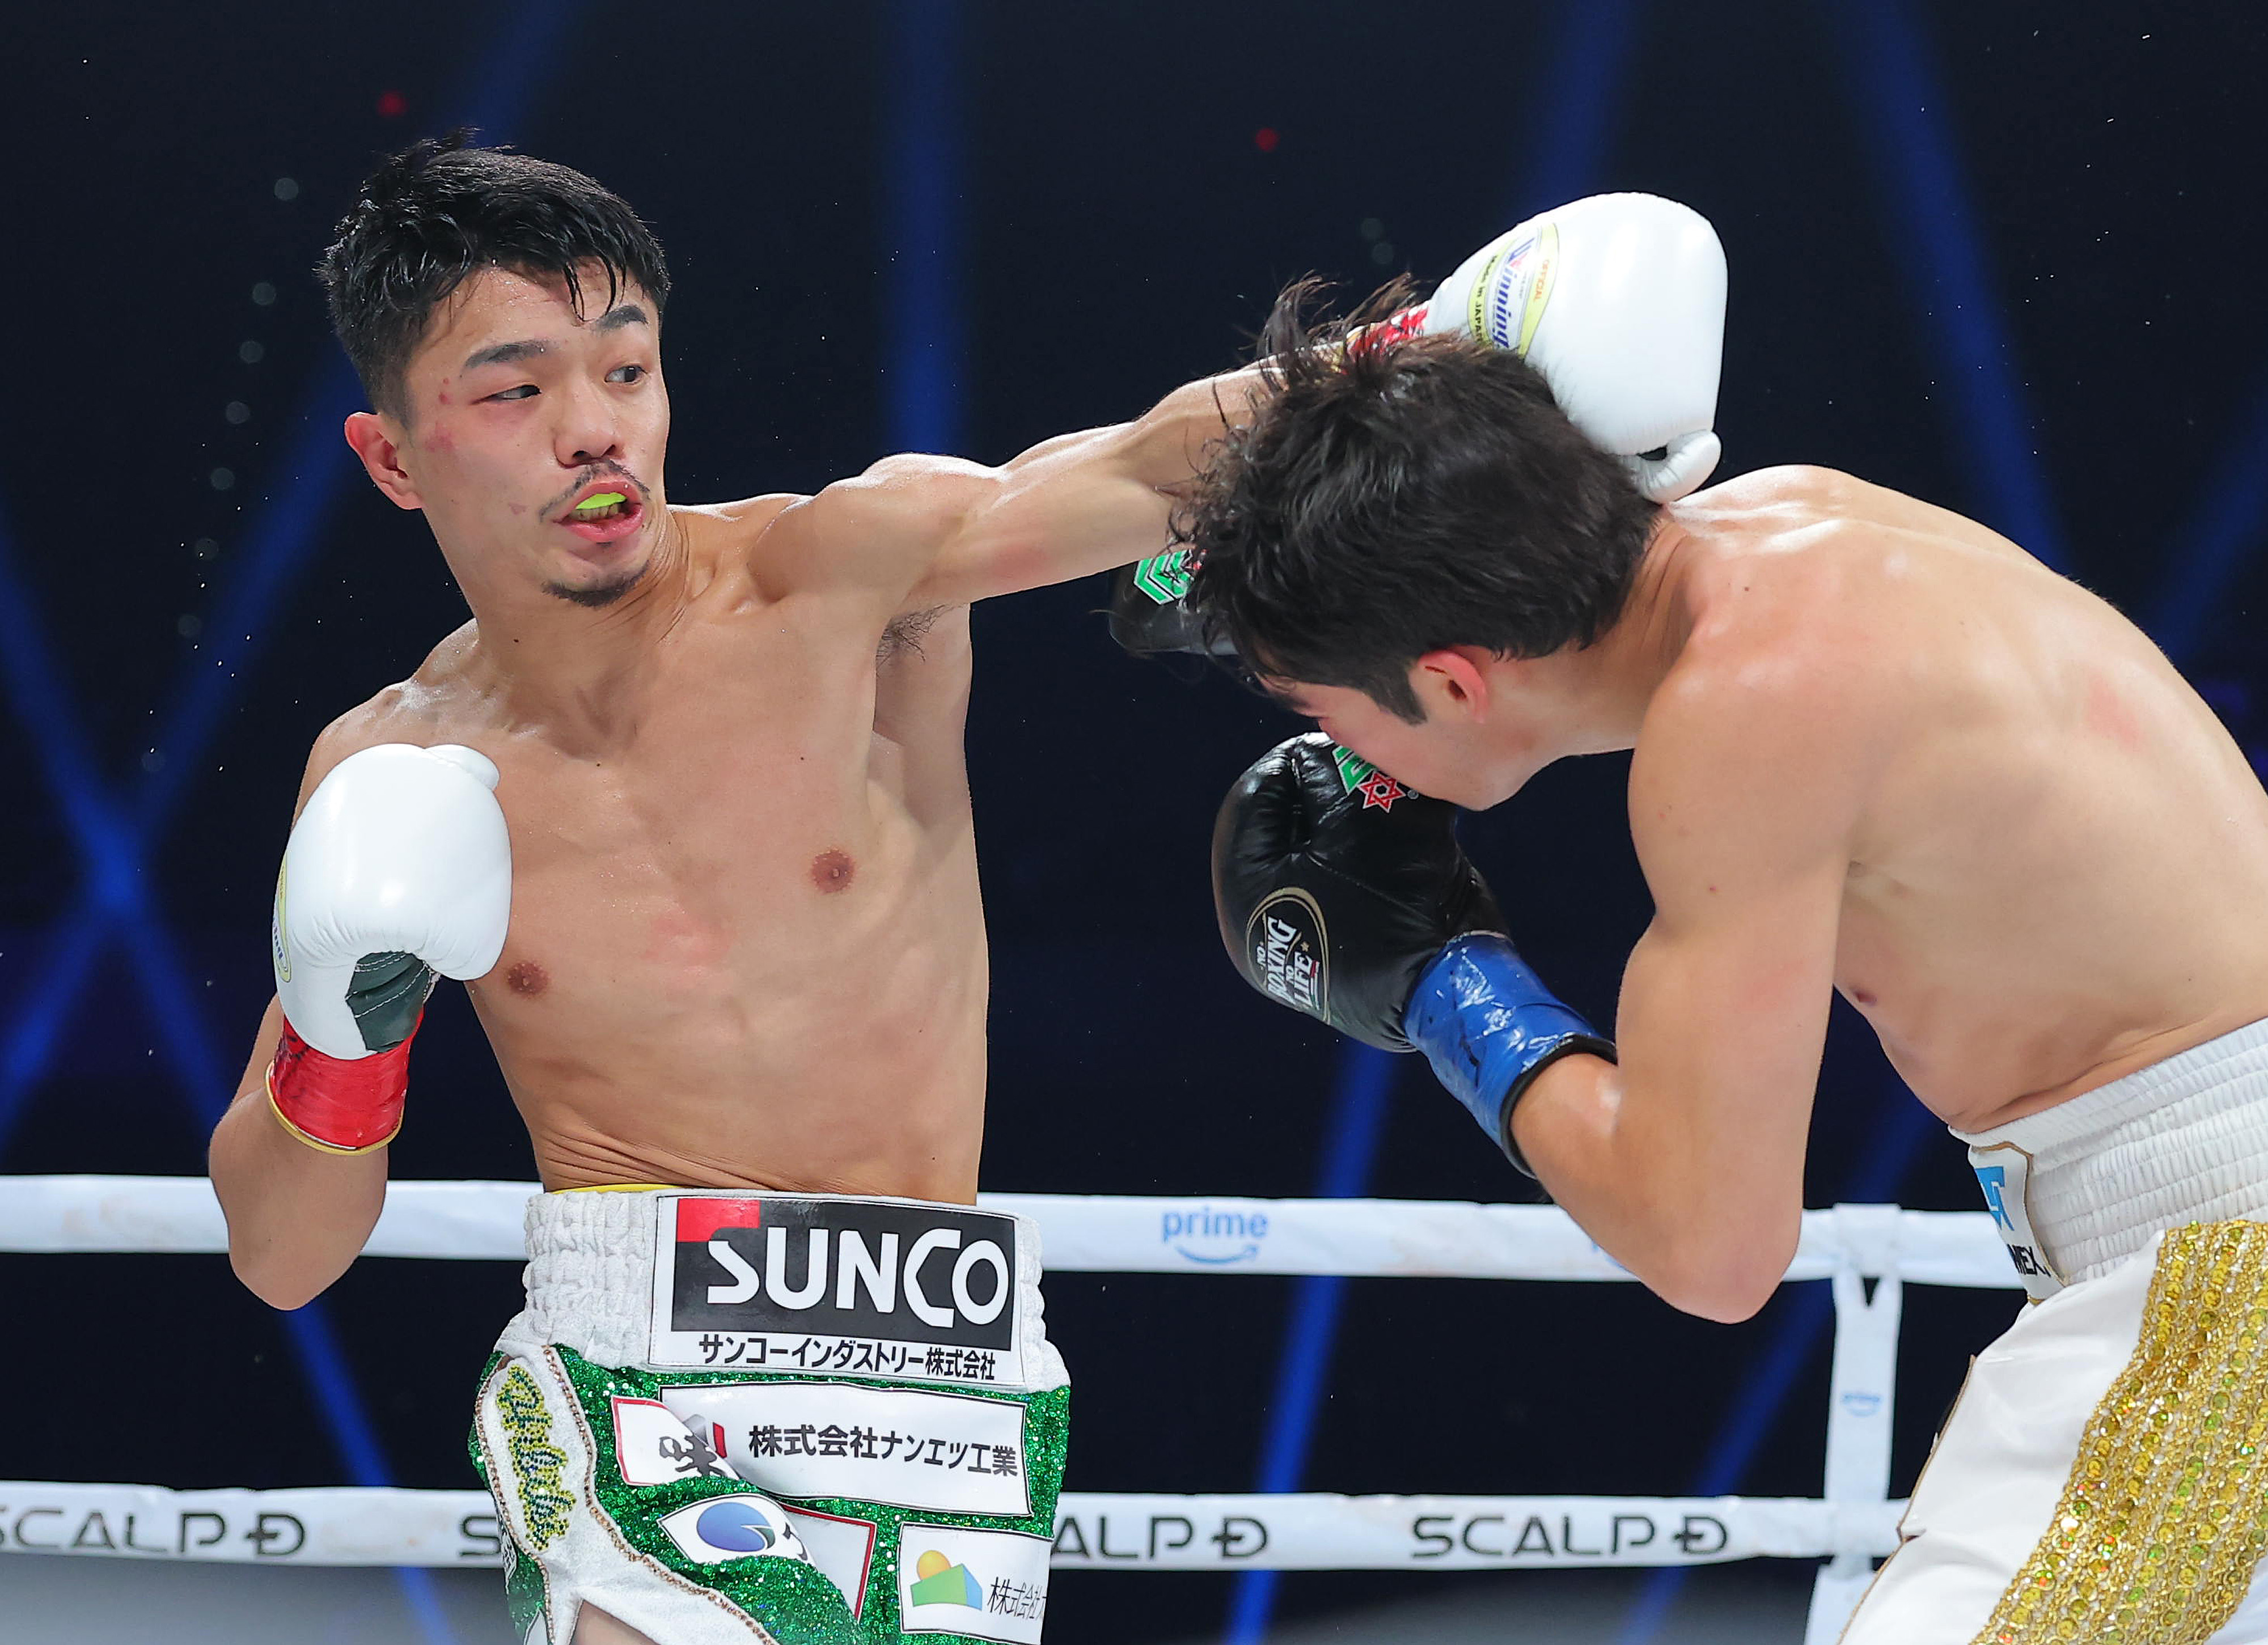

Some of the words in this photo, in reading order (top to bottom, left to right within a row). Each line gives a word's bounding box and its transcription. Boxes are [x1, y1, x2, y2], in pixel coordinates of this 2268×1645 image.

[1256, 946, 1266, 967] NO
[1267, 916, 1297, 1006] BOXING
[1285, 965, 1294, 985] NO
[1294, 951, 1314, 1008] LIFE
[1162, 1205, 1269, 1244] prime
[706, 1226, 1009, 1329] SUNCO
[699, 1333, 996, 1380] サンコーインダストリー株式会社
[748, 1423, 1018, 1477] 株式会社ナンエツ工業
[0, 1508, 226, 1553] CALP
